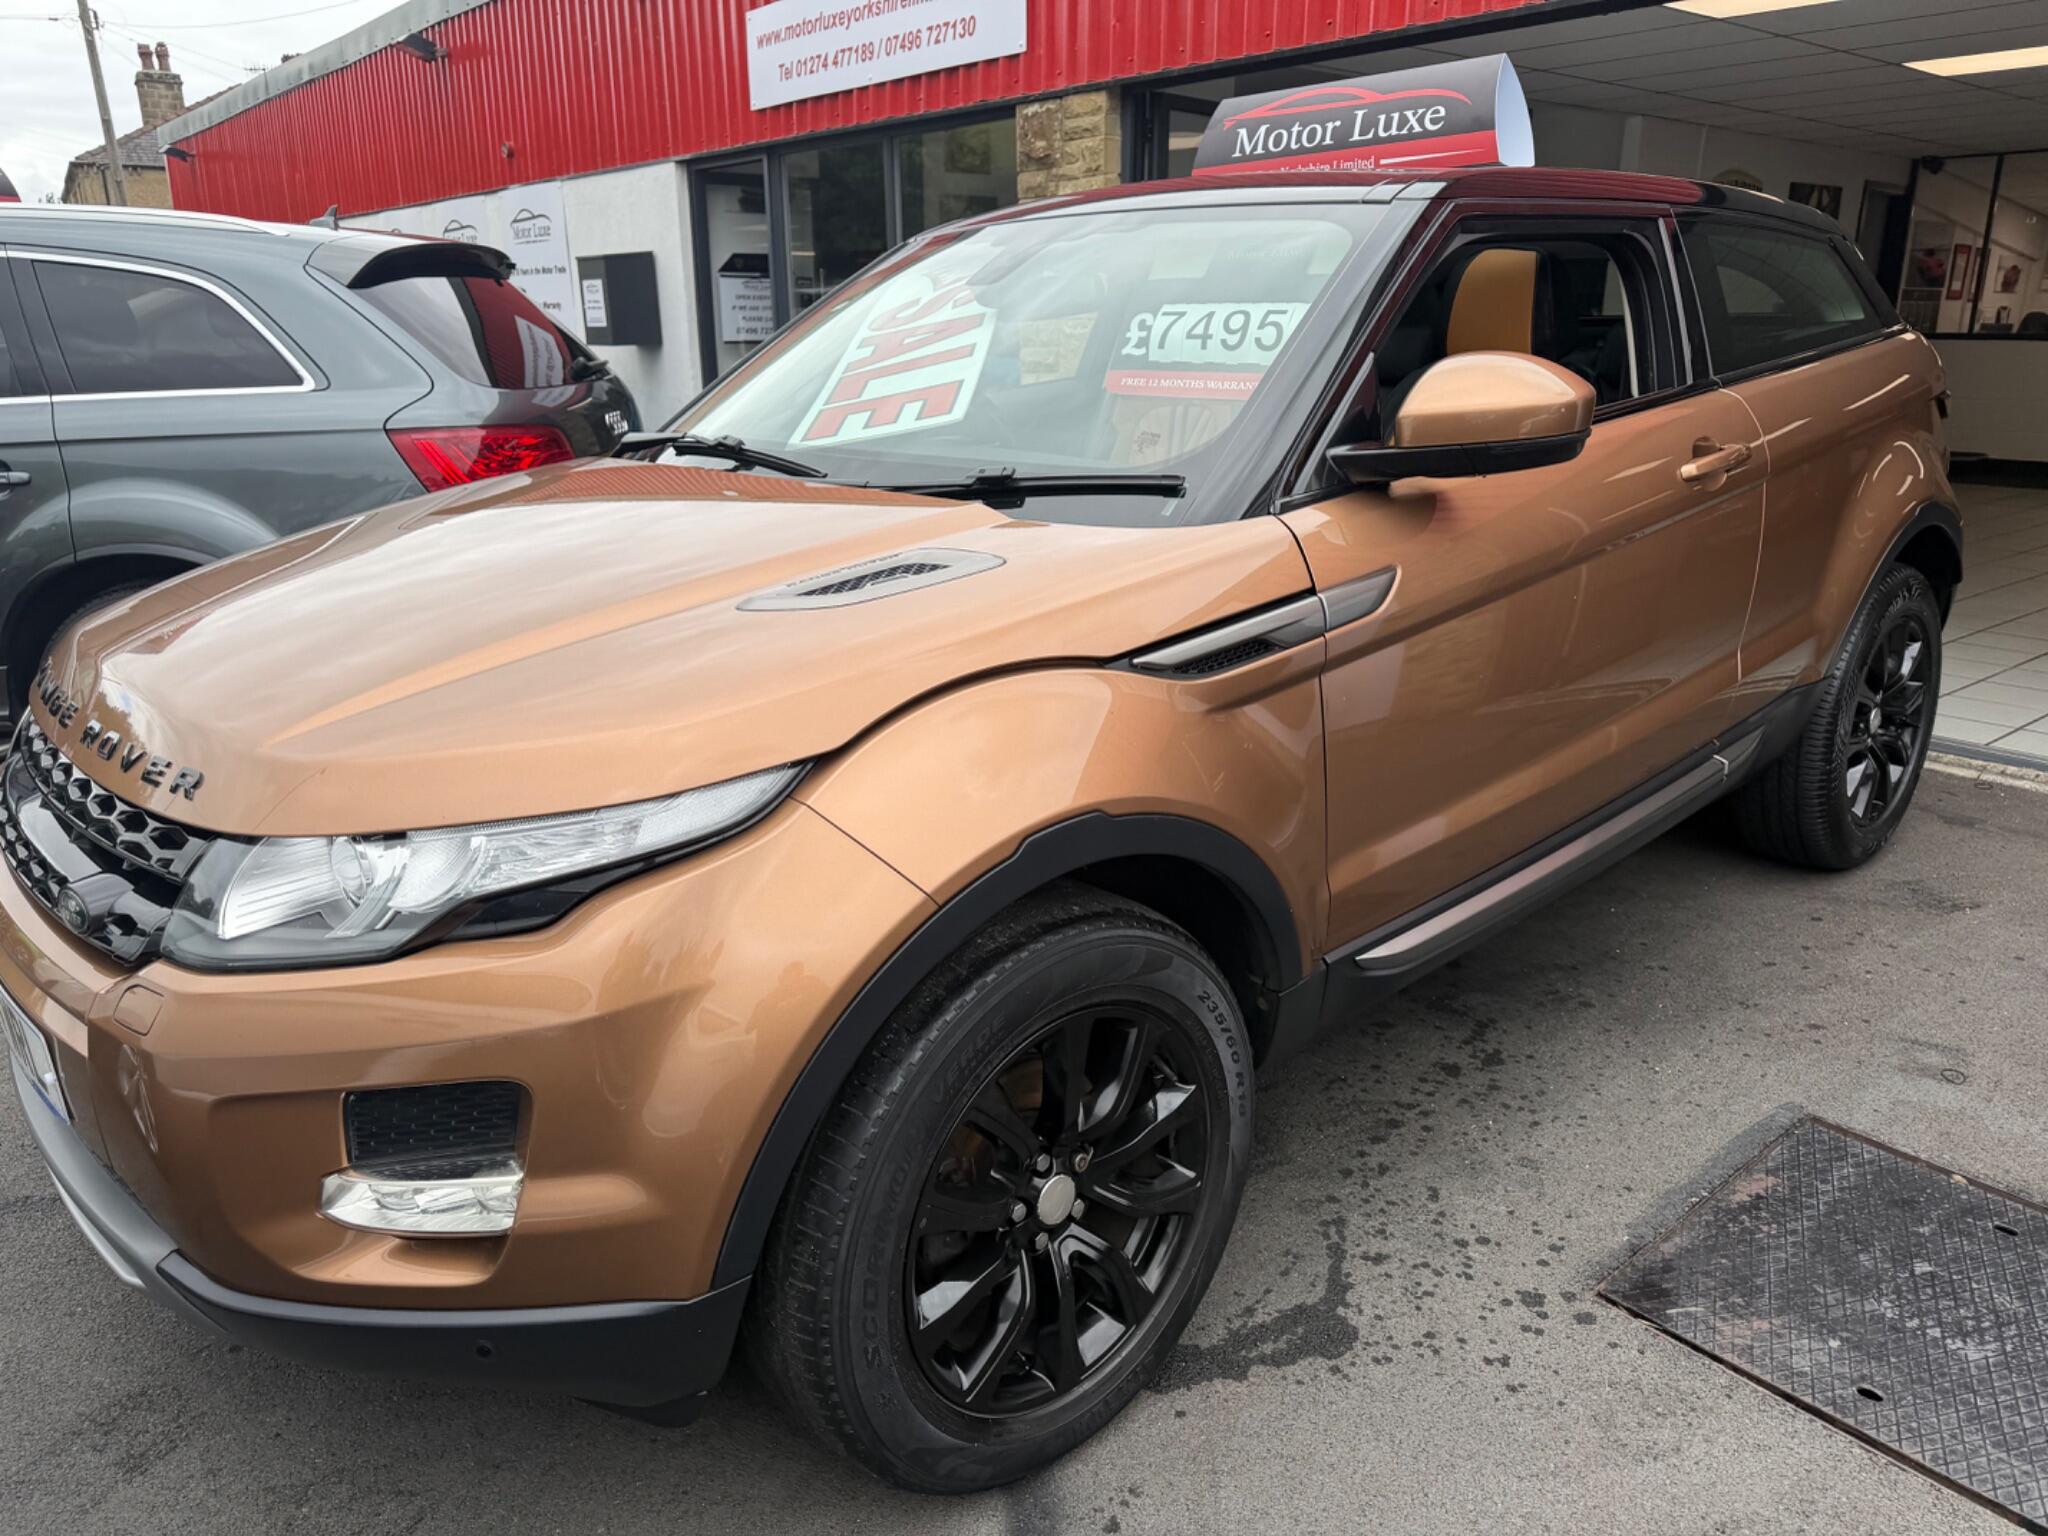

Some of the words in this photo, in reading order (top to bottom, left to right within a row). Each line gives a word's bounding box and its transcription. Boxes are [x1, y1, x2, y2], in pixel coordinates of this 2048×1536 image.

[756, 0, 932, 49] www.motorluxeyorkshire
[778, 61, 794, 82] Tel
[795, 54, 828, 78] 01274
[832, 41, 874, 69] 477189
[885, 29, 922, 57] 07496
[926, 15, 977, 47] 727130
[1231, 119, 1341, 158] Motor
[1349, 104, 1446, 142] Luxe
[800, 274, 987, 442] SALE
[1121, 309, 1288, 355] £7495
[1120, 377, 1147, 386] FREE
[1160, 378, 1204, 390] MONTHS
[80, 719, 204, 801] ROVER
[1198, 989, 1241, 1065] 235/60
